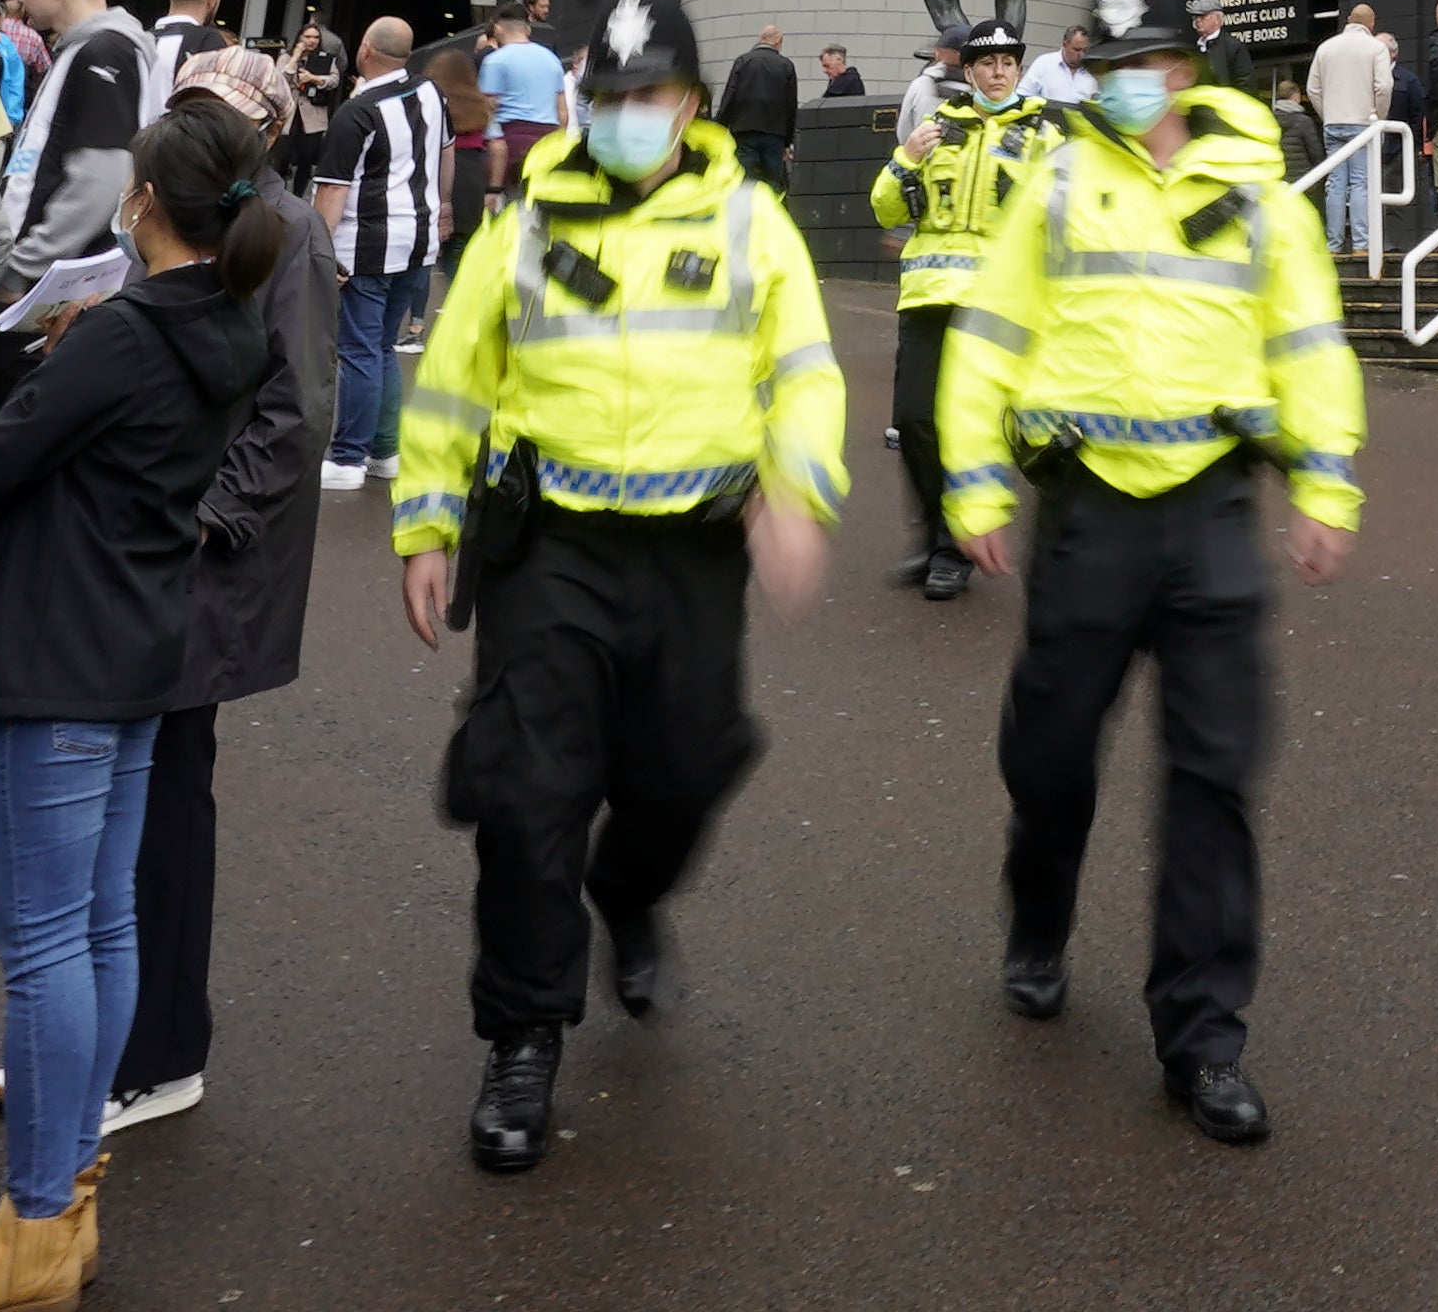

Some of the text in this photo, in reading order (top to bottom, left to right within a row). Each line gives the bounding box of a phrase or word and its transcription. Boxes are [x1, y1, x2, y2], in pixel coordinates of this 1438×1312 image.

[1223, 5, 1296, 26] WGATE CLUB &
[1253, 25, 1288, 42] BOXES
